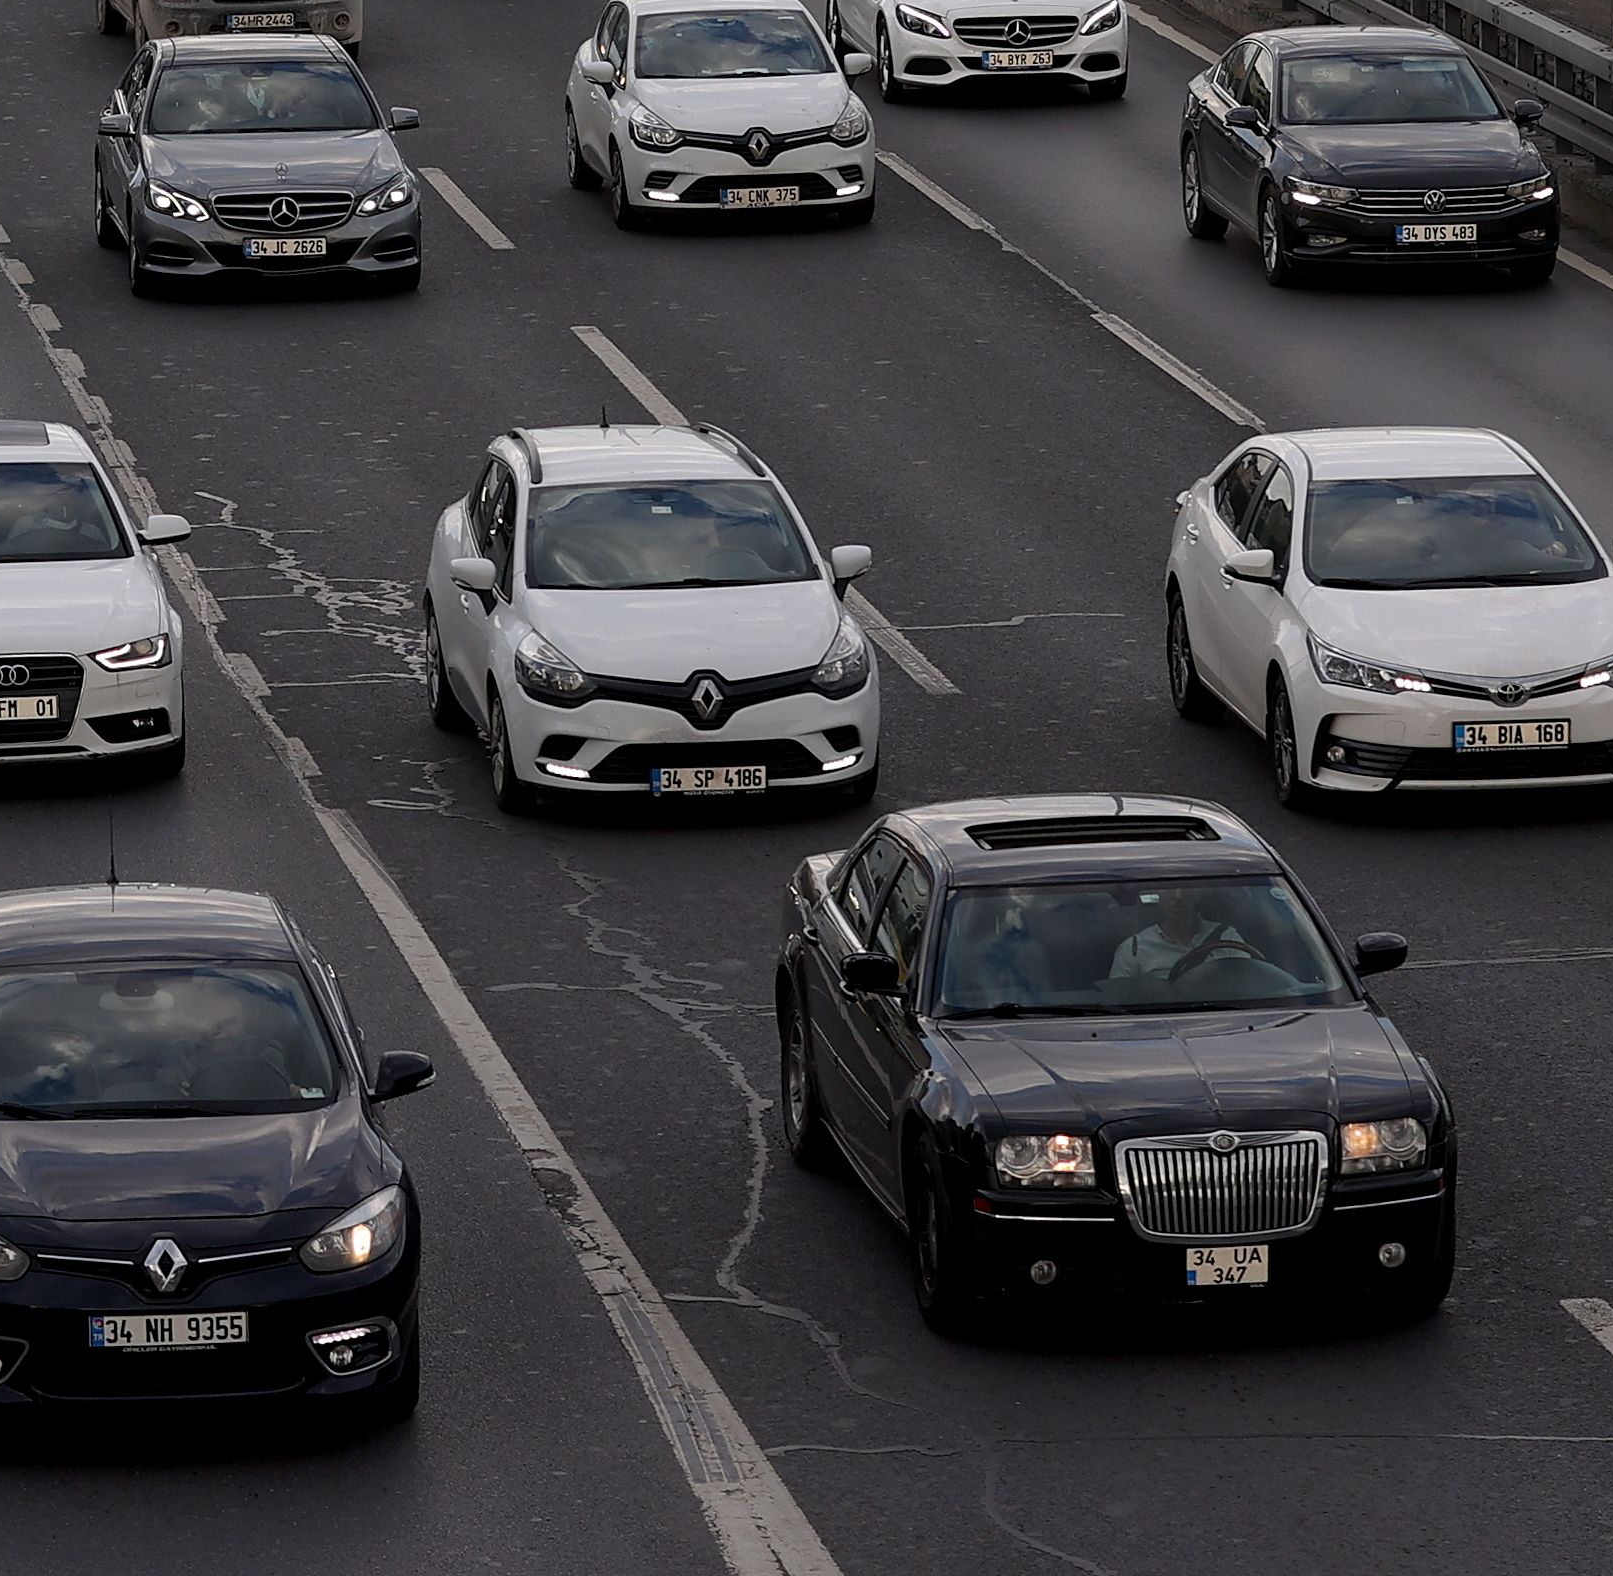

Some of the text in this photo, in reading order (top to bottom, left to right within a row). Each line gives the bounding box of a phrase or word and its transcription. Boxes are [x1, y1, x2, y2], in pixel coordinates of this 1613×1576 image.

[234, 14, 293, 27] 34 HR 2443
[990, 53, 1051, 66] 34 BYR 263
[728, 188, 797, 203] 34 CNK 375
[1403, 226, 1474, 241] 34 DYS 483
[252, 240, 323, 254] 34 JC 2626
[36, 699, 54, 717] 01
[1466, 724, 1564, 745] 34 BIA 168
[662, 768, 763, 788] 34 SP 4186
[1193, 1247, 1262, 1266] 34 UA
[1213, 1266, 1247, 1284] 347
[105, 1320, 133, 1344] 34
[146, 1318, 174, 1343] NH
[187, 1316, 243, 1341] 9355
